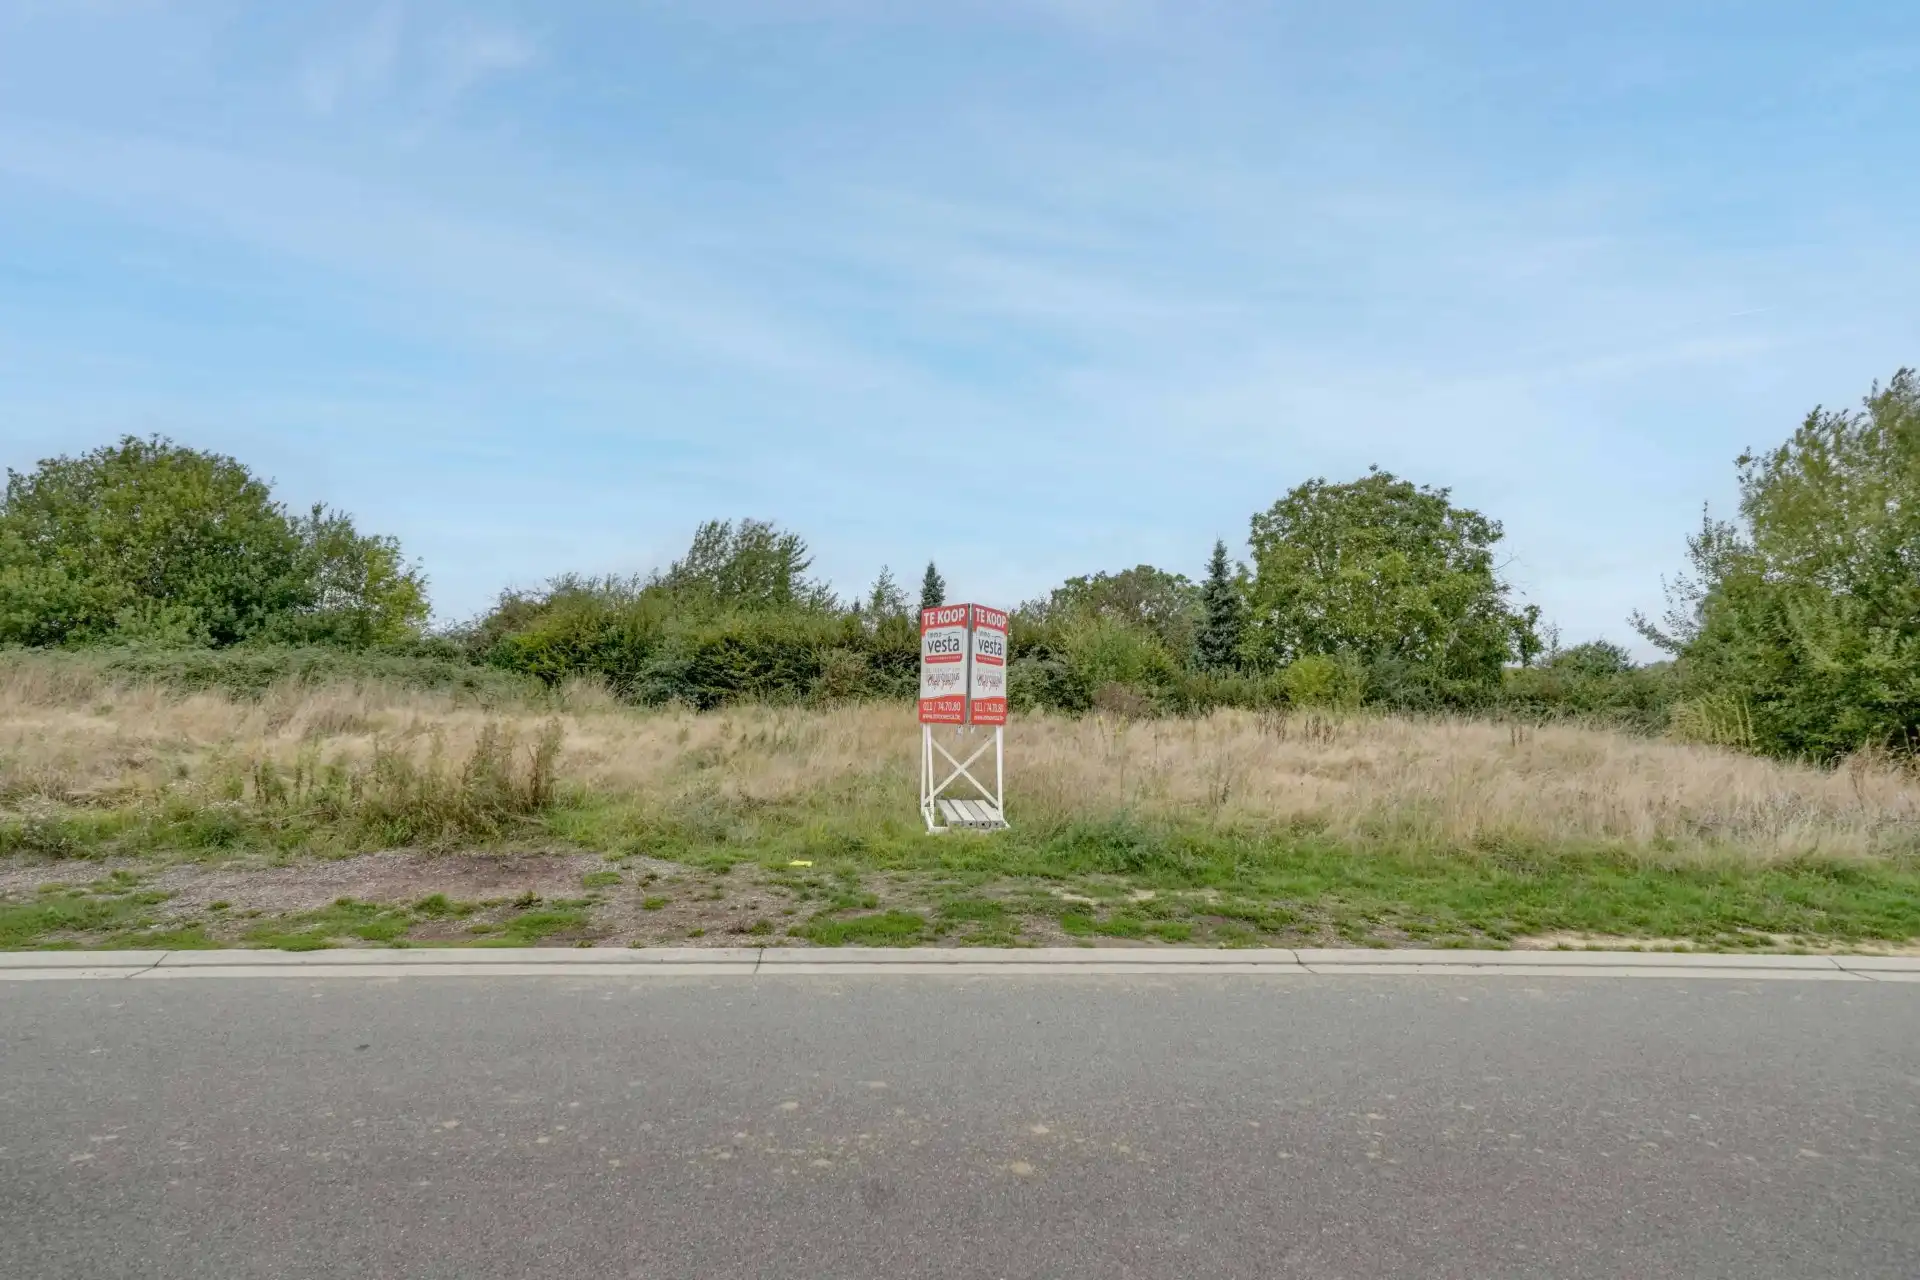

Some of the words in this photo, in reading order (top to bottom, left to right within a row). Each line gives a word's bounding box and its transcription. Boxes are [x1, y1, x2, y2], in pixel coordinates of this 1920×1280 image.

[924, 612, 935, 625] TE
[938, 608, 965, 624] KOOP
[976, 608, 985, 623] TE
[987, 611, 1006, 628] KOOP
[928, 636, 960, 653] vesta
[978, 638, 1002, 656] vesta
